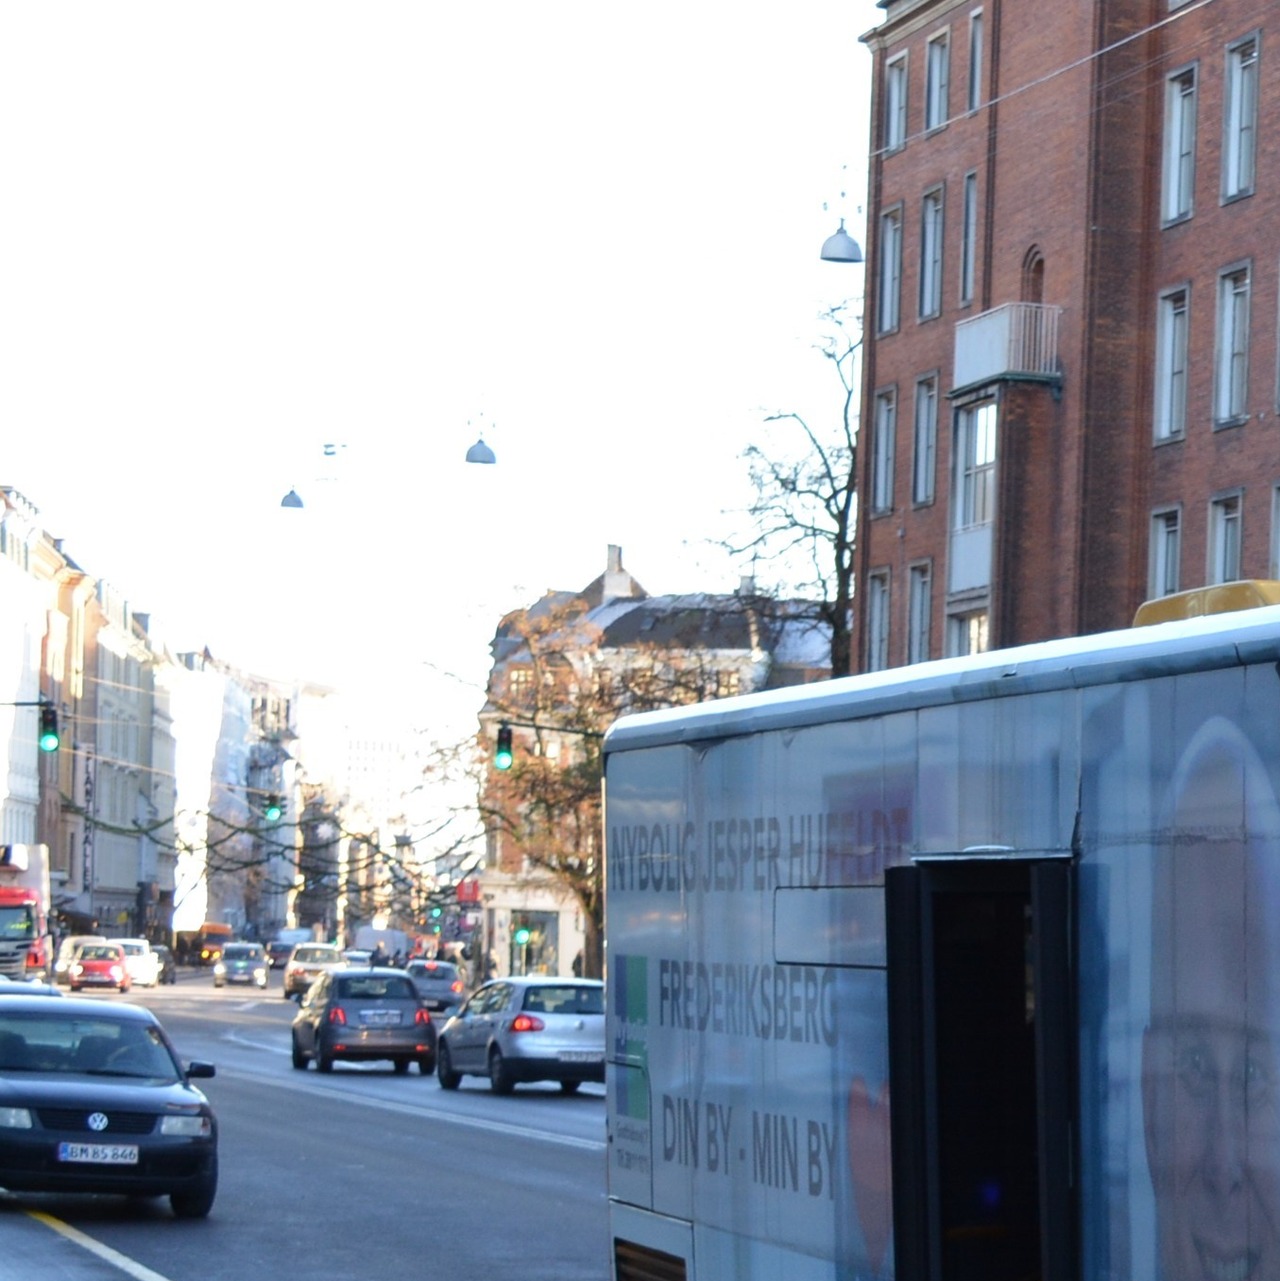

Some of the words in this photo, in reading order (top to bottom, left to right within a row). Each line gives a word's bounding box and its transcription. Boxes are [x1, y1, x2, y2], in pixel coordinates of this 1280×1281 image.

[612, 822, 696, 892] NYBOLIG
[703, 816, 780, 892] JESPER
[660, 958, 840, 1048] FREDERIKSBERG
[663, 1094, 699, 1169] DIN
[706, 1102, 732, 1175] BY
[752, 1110, 798, 1192] MIN
[808, 1120, 839, 1200] BY
